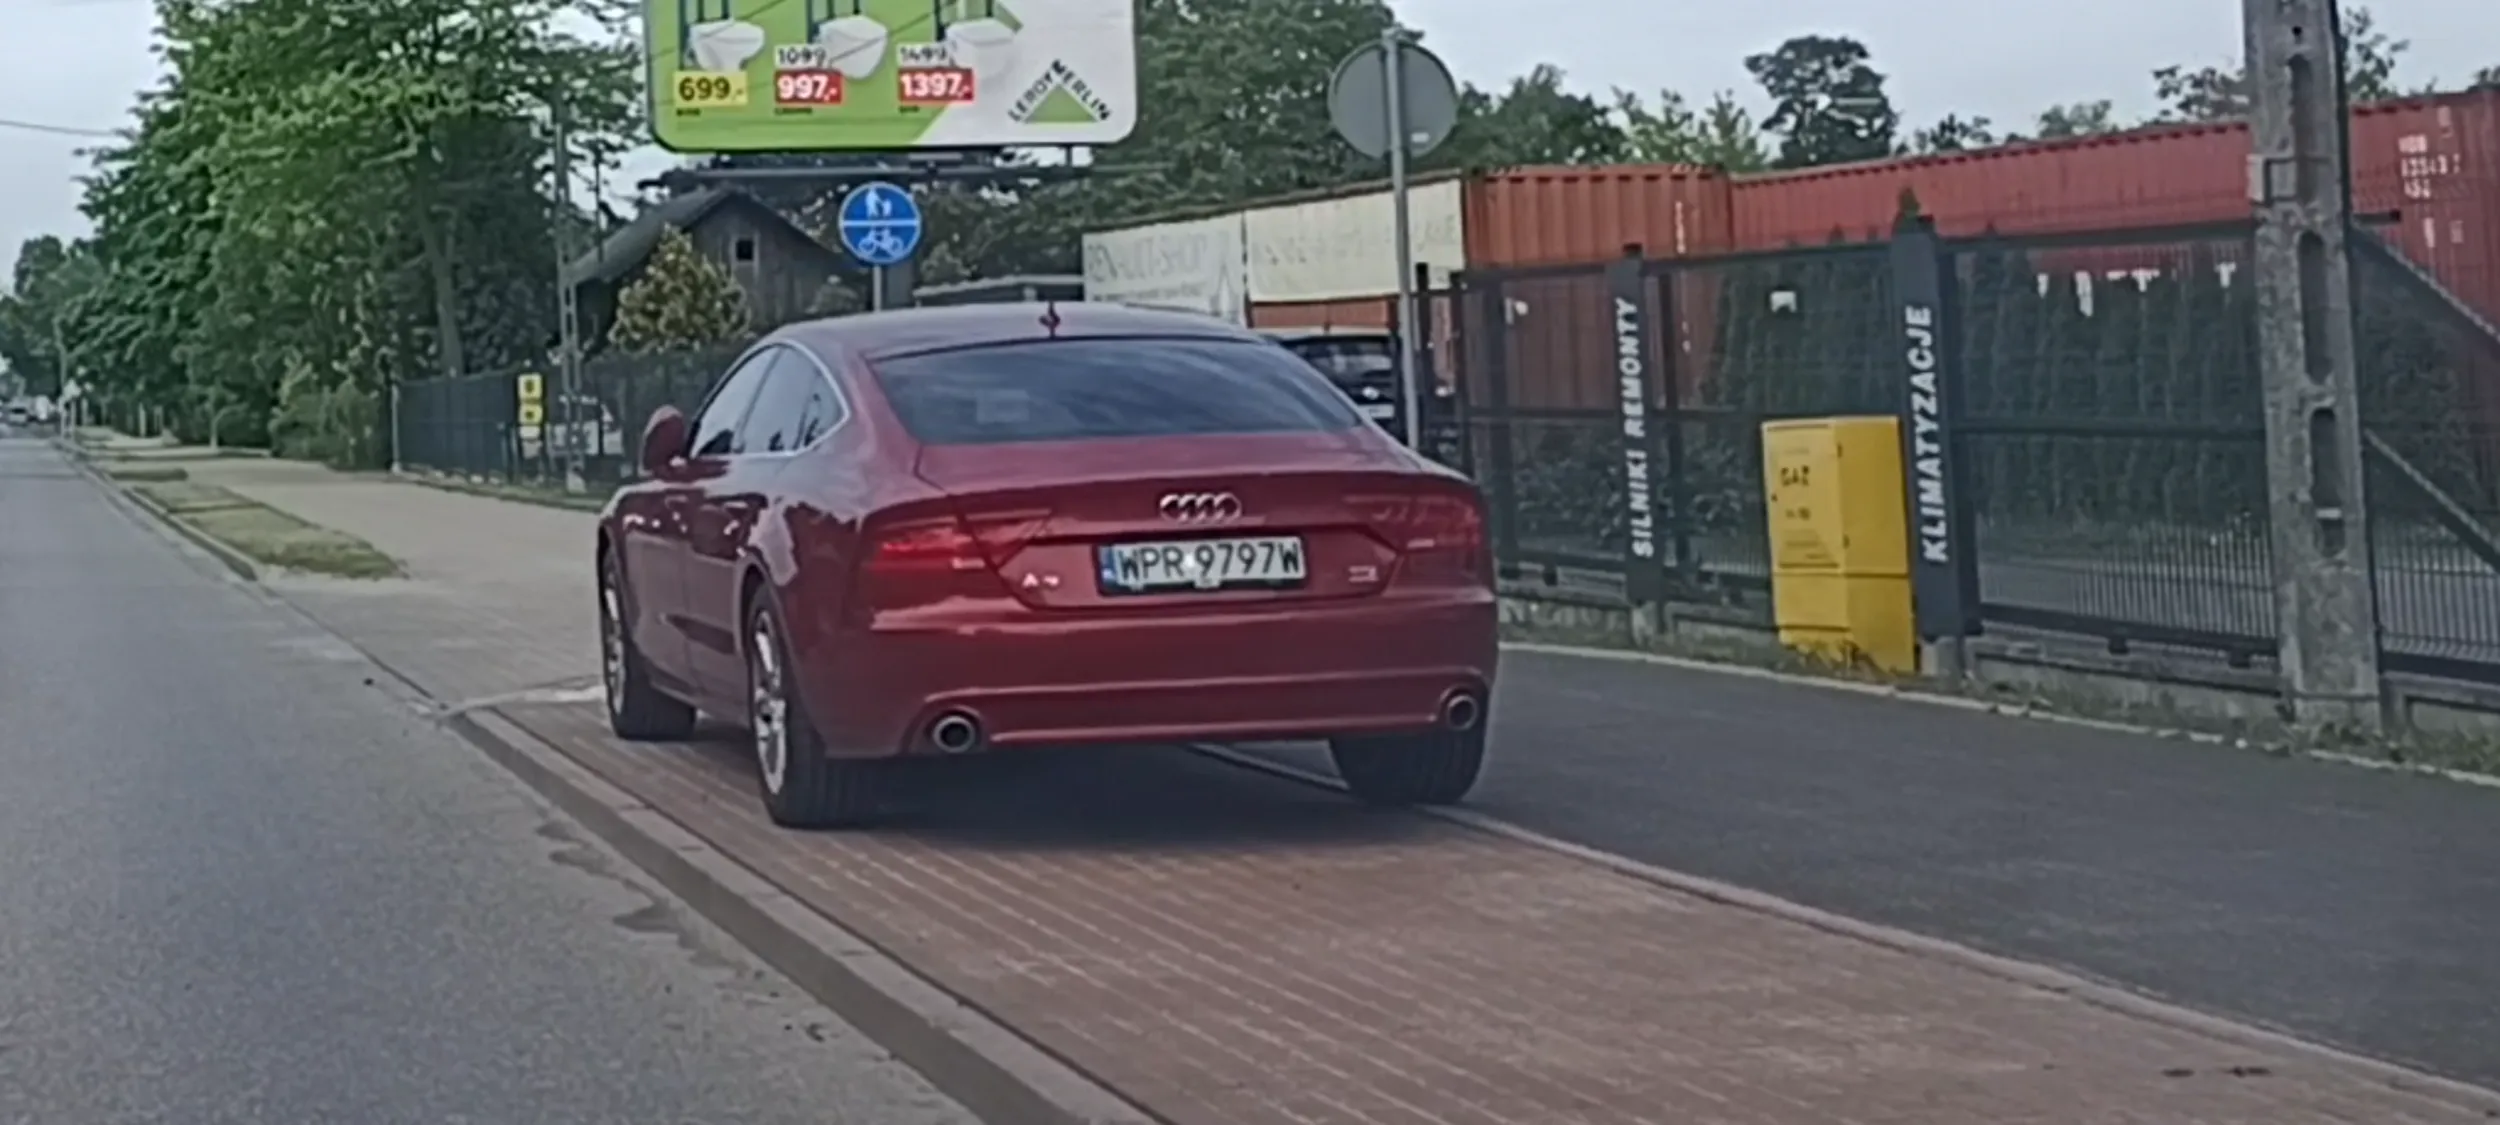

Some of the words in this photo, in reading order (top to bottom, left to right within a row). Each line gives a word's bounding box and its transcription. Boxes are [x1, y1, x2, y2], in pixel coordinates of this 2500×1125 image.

[1007, 66, 1056, 123] LEROY
[1051, 57, 1114, 121] MERLIN
[1615, 298, 1646, 438] REMONTY
[1905, 305, 1949, 563] KLIMATYZACJE
[1626, 450, 1654, 558] SILNIKI
[1117, 546, 1186, 582] WPR
[1194, 540, 1300, 577] 9797W
